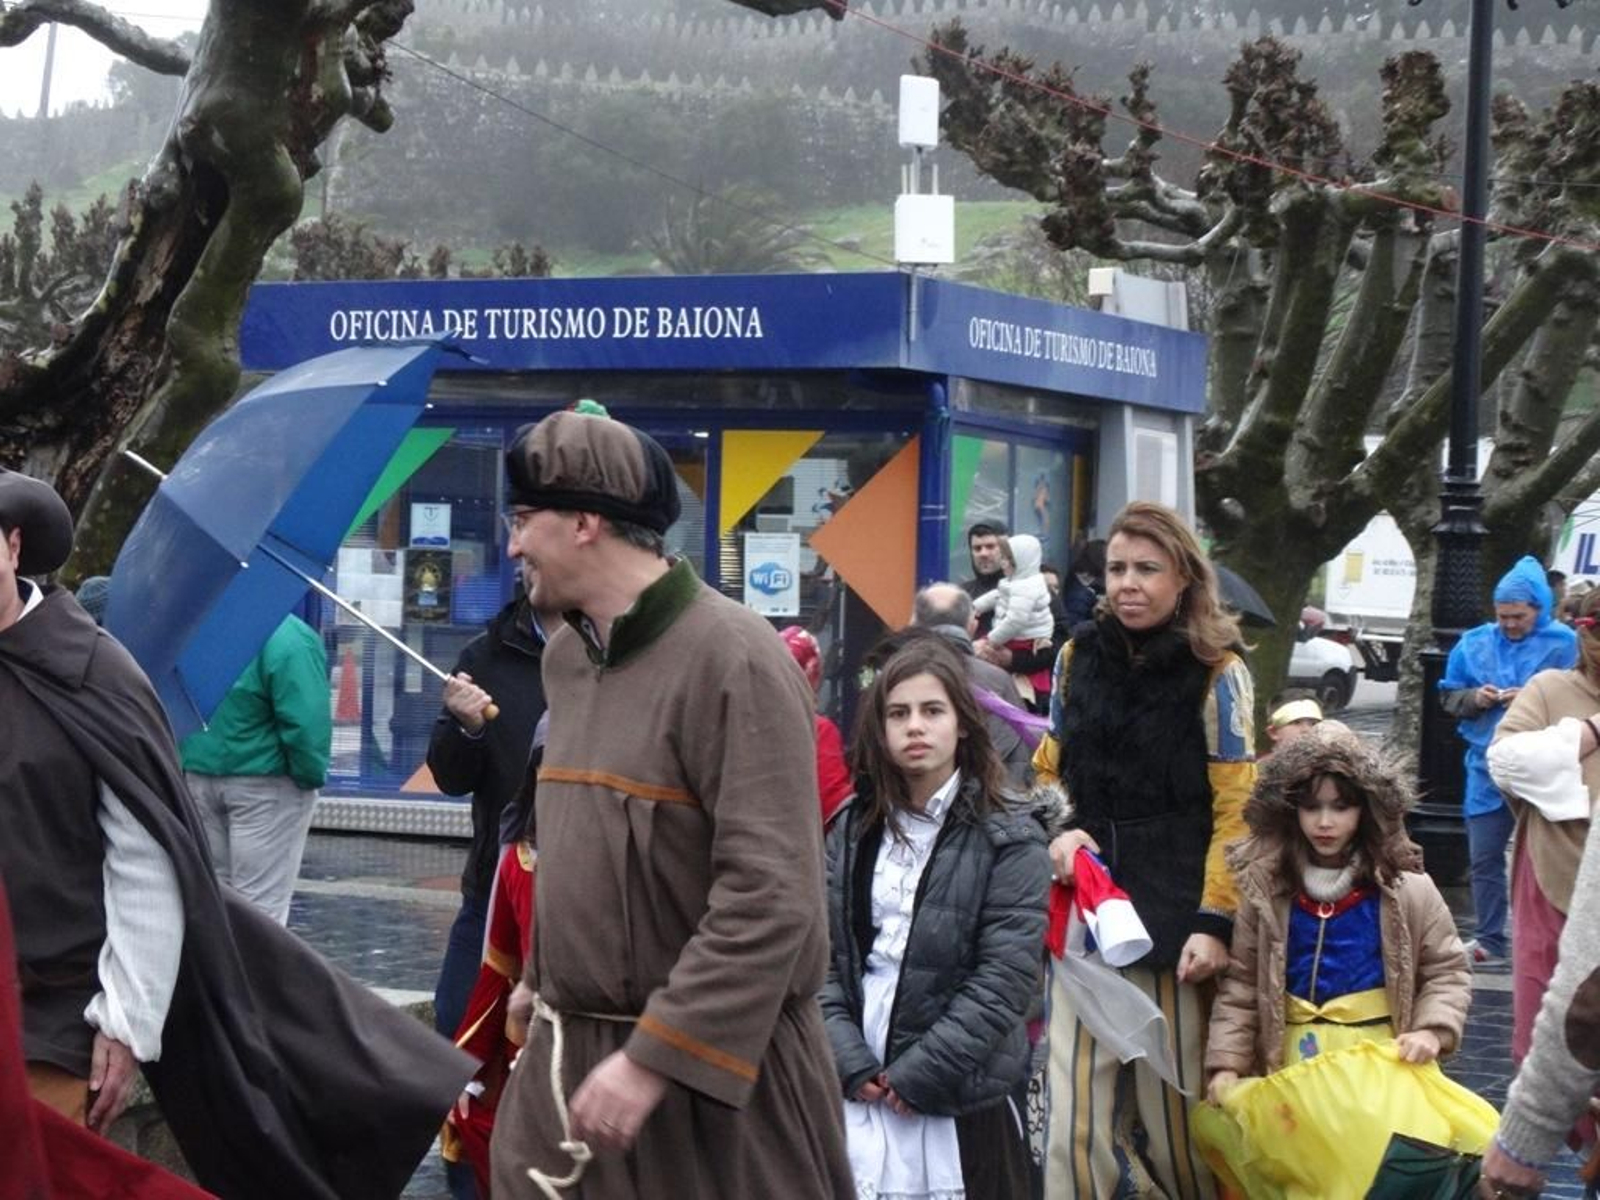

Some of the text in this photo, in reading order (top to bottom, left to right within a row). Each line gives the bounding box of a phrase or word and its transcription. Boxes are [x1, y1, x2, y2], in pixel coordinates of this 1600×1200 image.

[330, 306, 764, 341] OFICINA DE TURISMO DE BAIONA
[969, 316, 1158, 378] OFICINA DE TURISMO DE BAIONA
